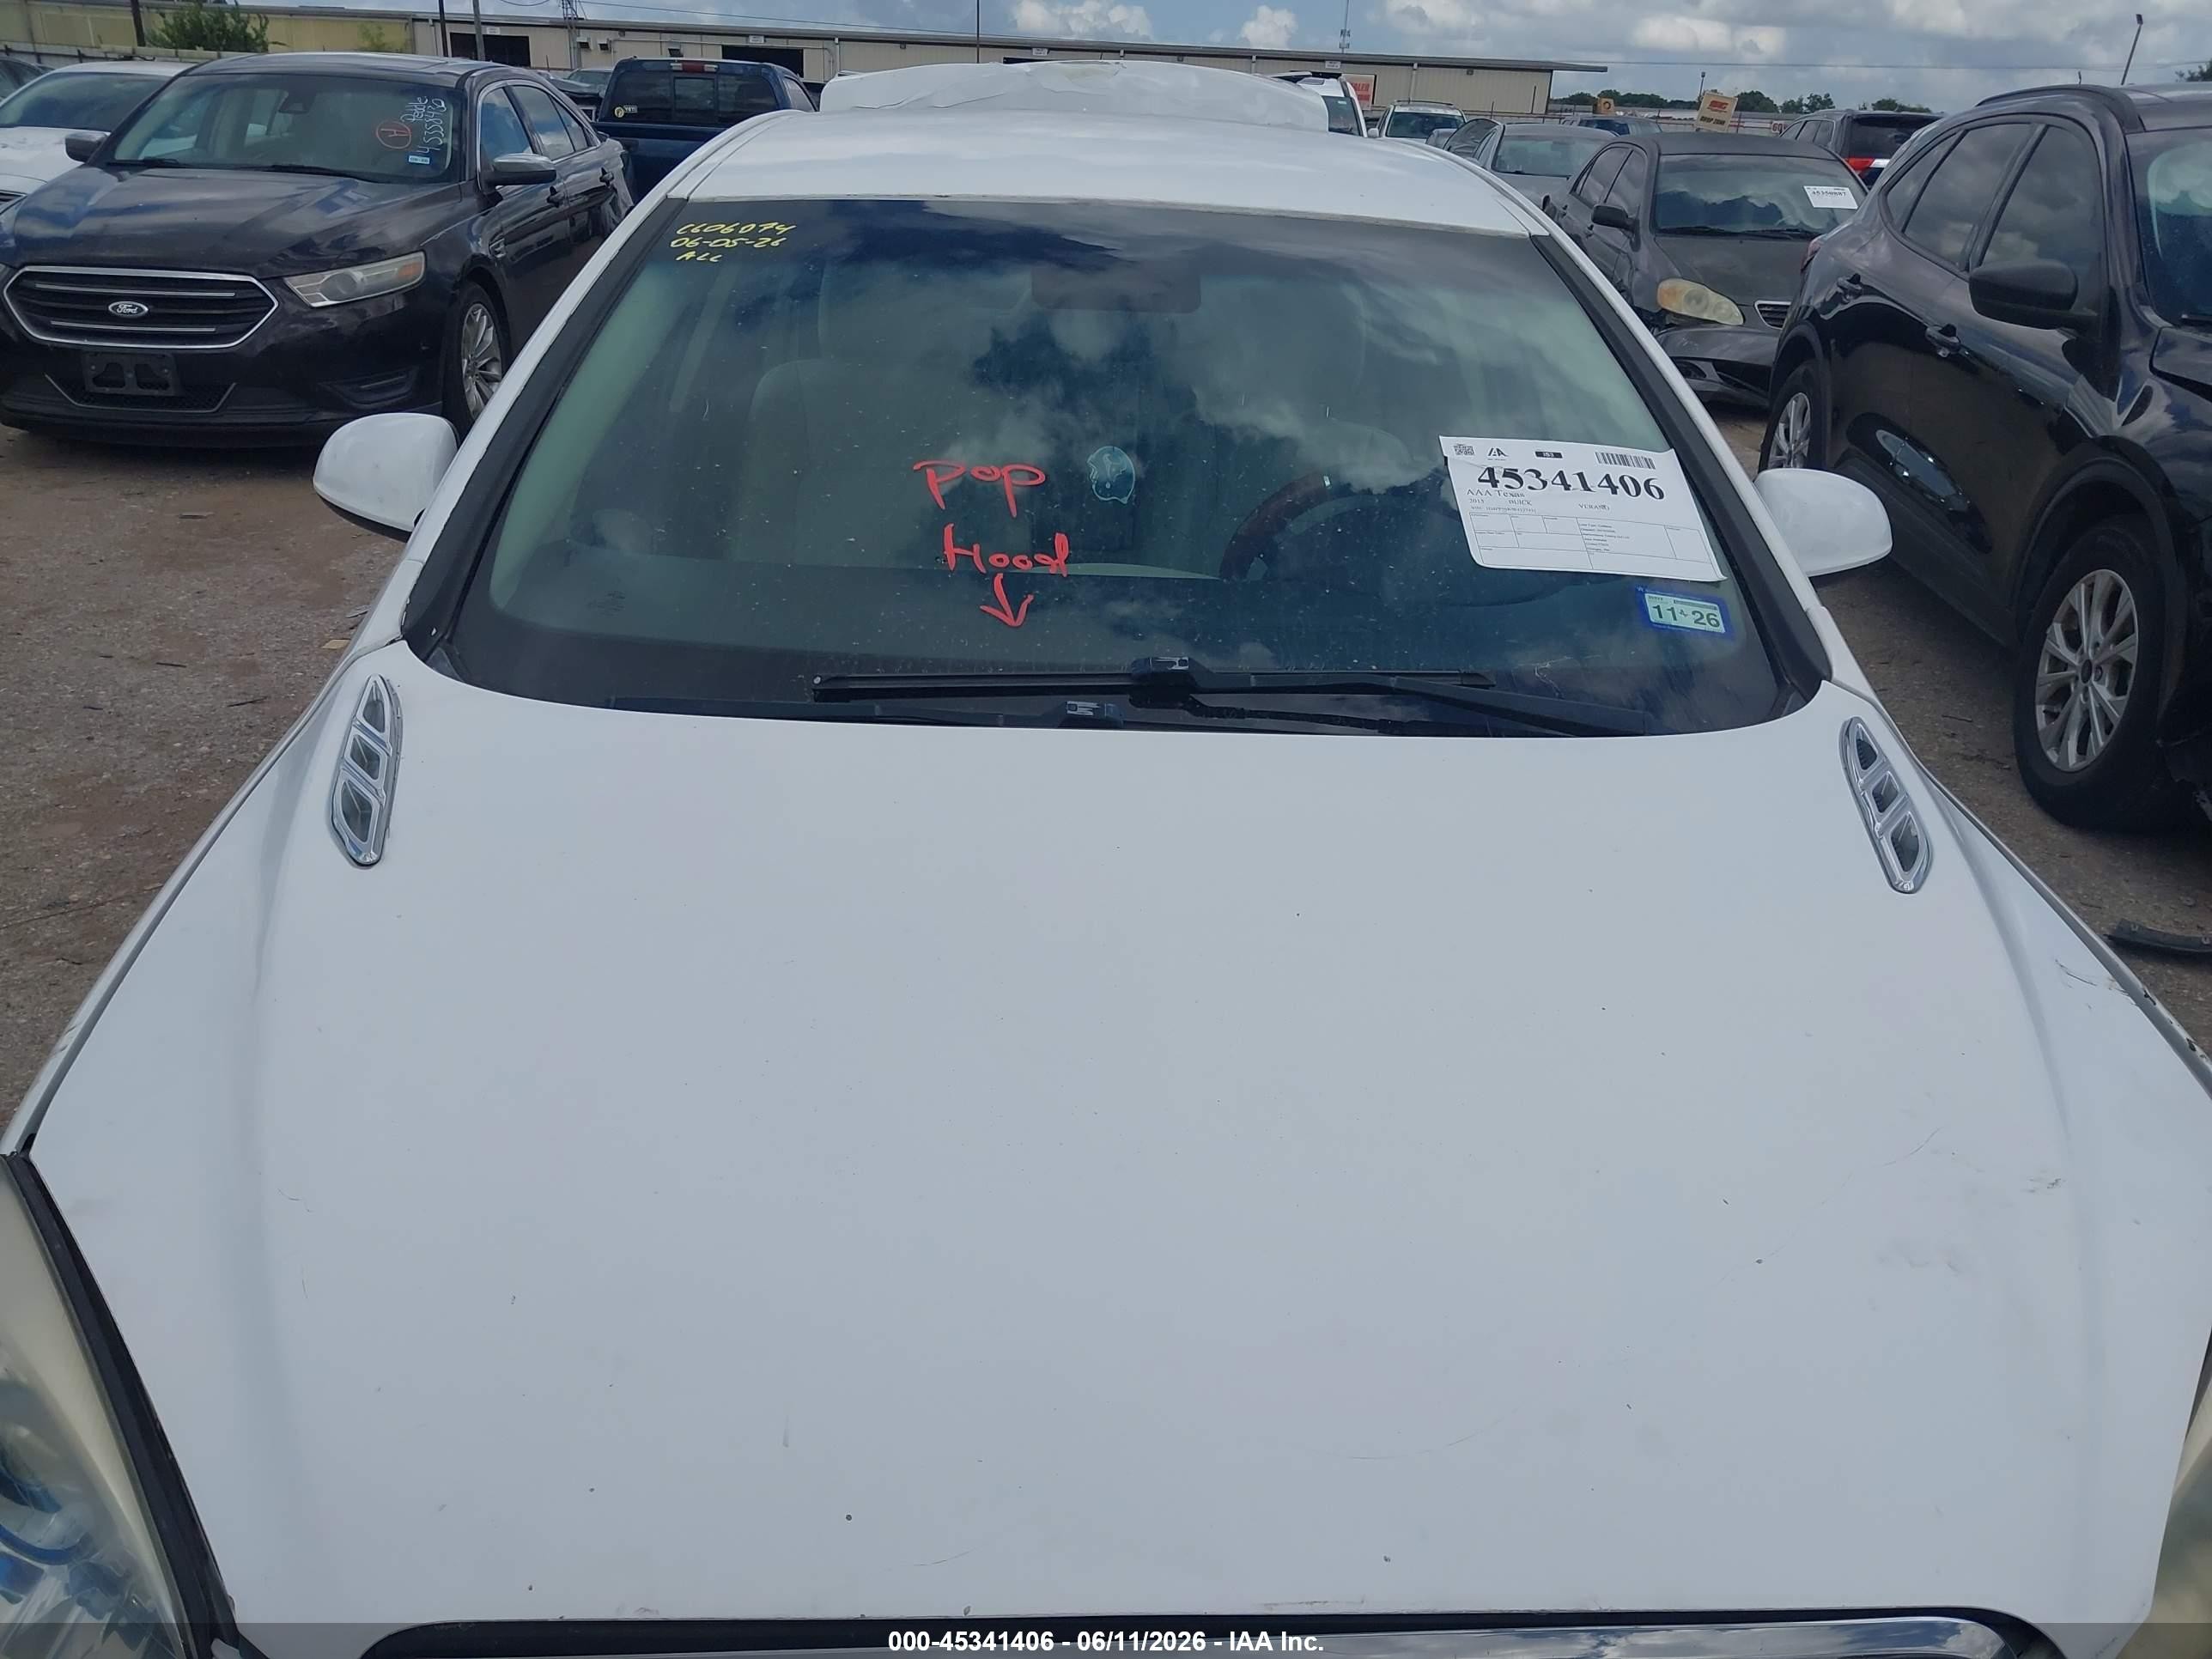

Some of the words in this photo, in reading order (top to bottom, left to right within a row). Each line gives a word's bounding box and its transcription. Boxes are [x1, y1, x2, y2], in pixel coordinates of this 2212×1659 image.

[117, 304, 138, 313] Ford
[1478, 466, 1665, 500] 45341406
[1496, 489, 1525, 498] Texas
[943, 523, 1069, 577] Hood
[1652, 605, 1677, 622] 11
[1692, 611, 1720, 628] 26
